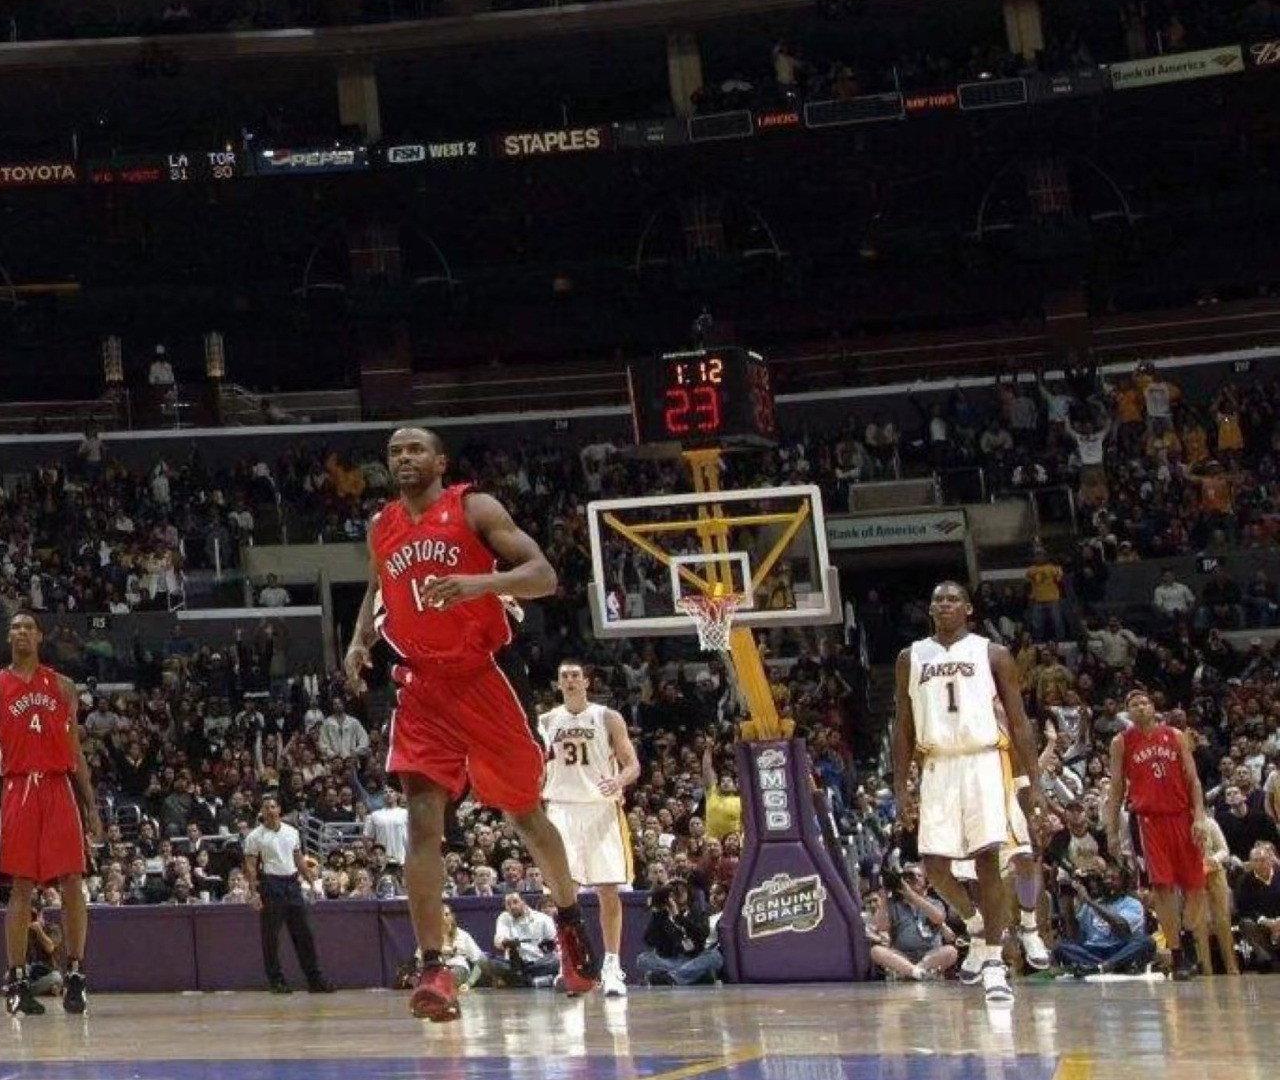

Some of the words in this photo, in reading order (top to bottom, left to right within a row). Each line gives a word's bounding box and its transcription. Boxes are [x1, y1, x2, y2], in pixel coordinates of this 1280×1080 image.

[505, 129, 601, 155] STAPLES
[168, 154, 188, 167] LA
[207, 152, 237, 165] TOR
[0, 165, 76, 181] TOYOTA
[666, 386, 720, 432] 23
[386, 539, 460, 579] RAPTORS
[946, 682, 958, 712] 1
[29, 713, 42, 733] 4
[563, 742, 589, 765] 31
[754, 903, 813, 923] DRAFT
